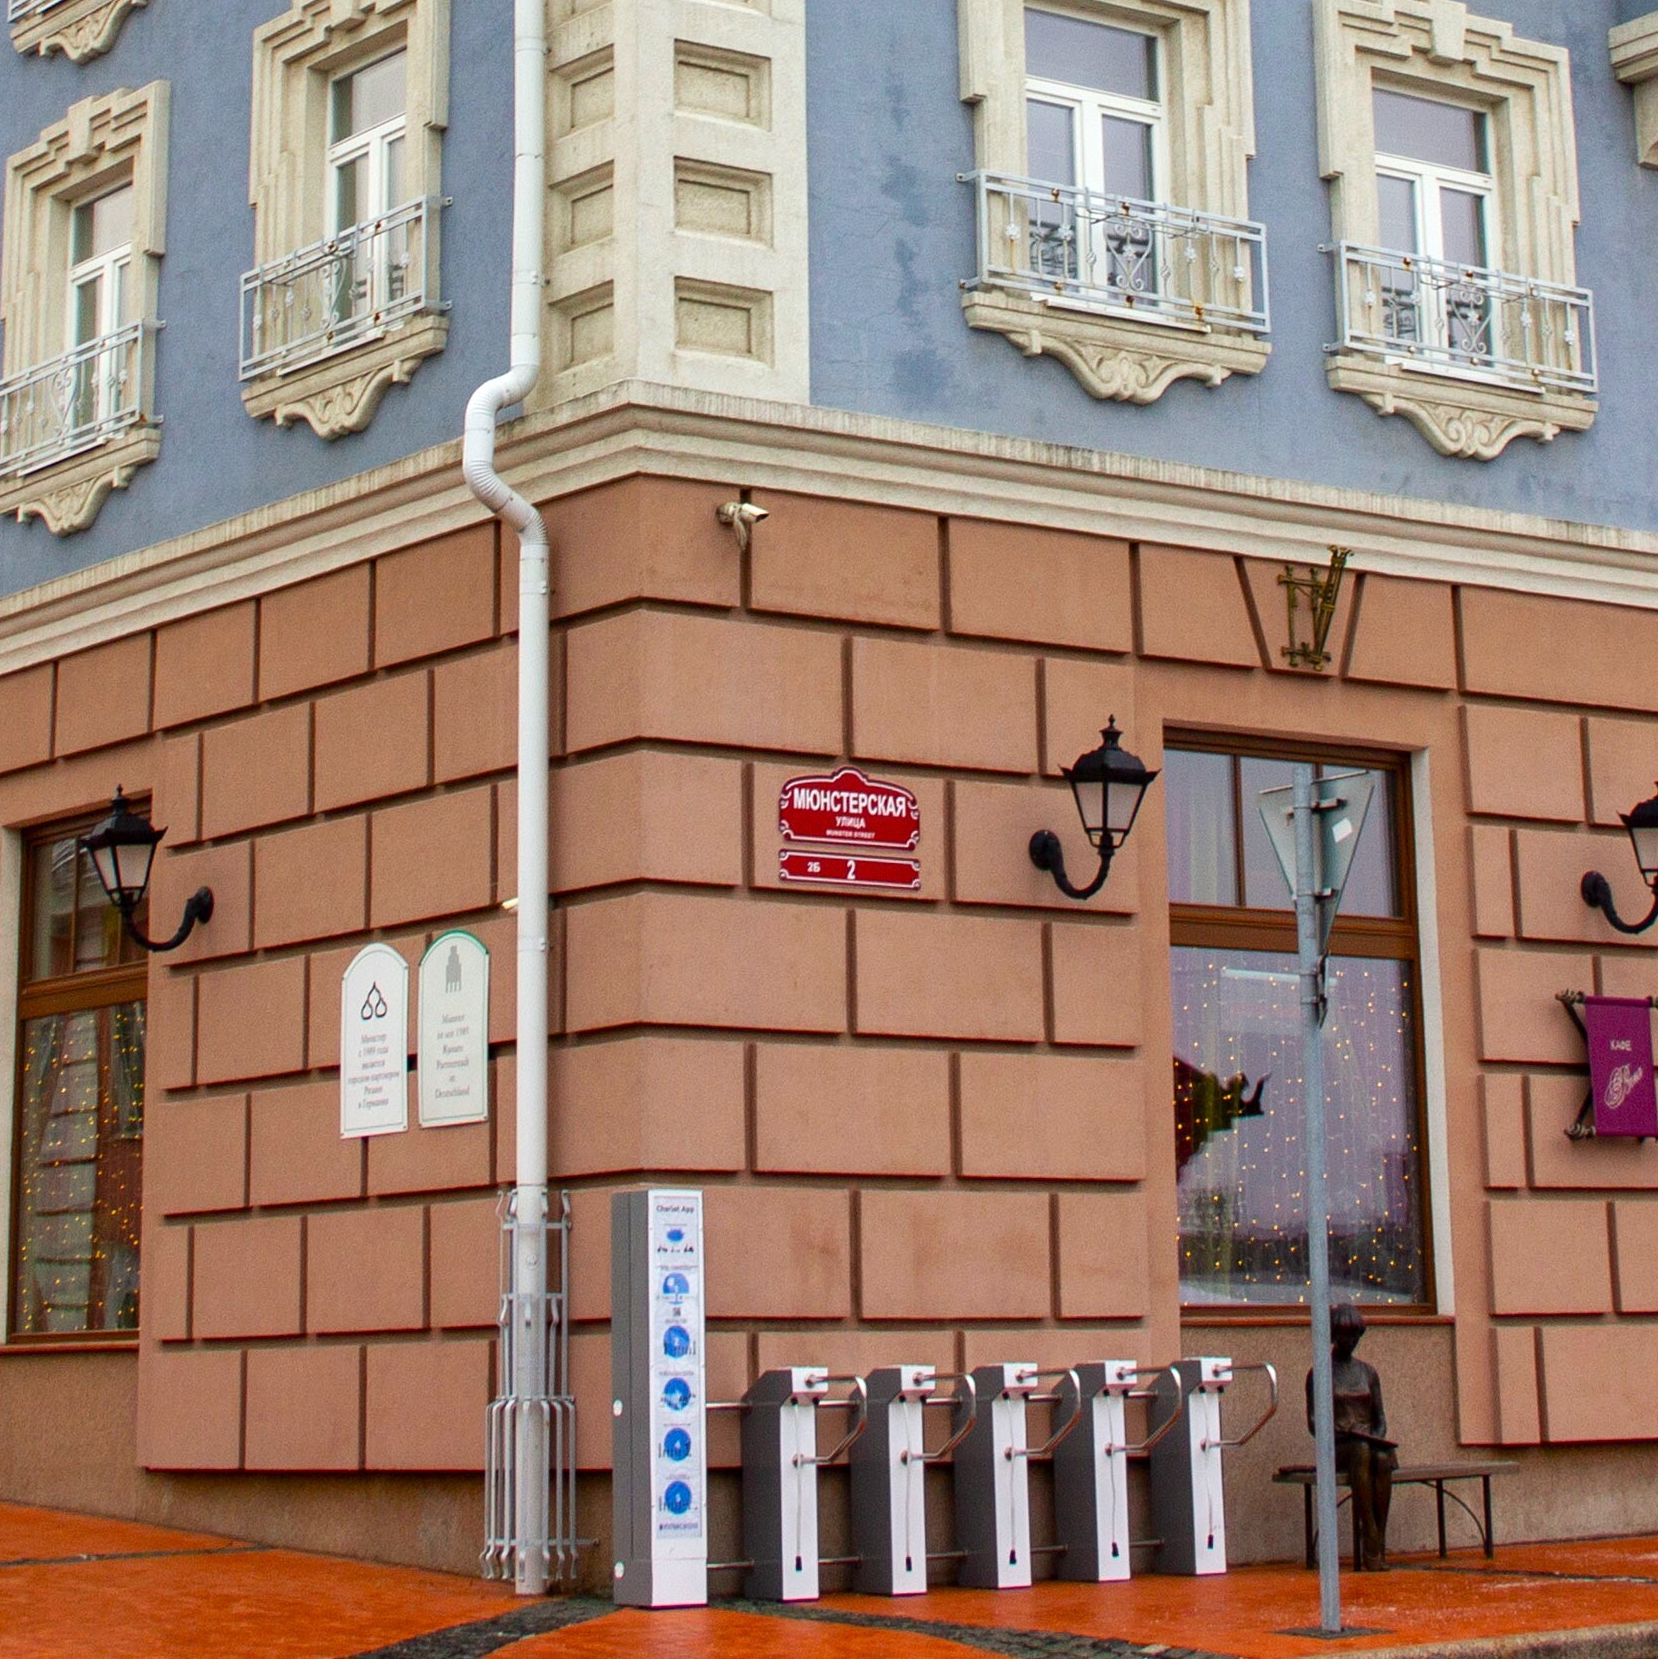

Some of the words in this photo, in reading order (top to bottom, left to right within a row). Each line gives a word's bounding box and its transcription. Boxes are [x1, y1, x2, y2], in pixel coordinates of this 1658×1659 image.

[793, 788, 906, 817] МЮНСТЕРСКАЯ
[835, 816, 866, 829] УЛИЦА
[847, 860, 856, 879] 2
[1610, 1039, 1632, 1052] КАФЕ
